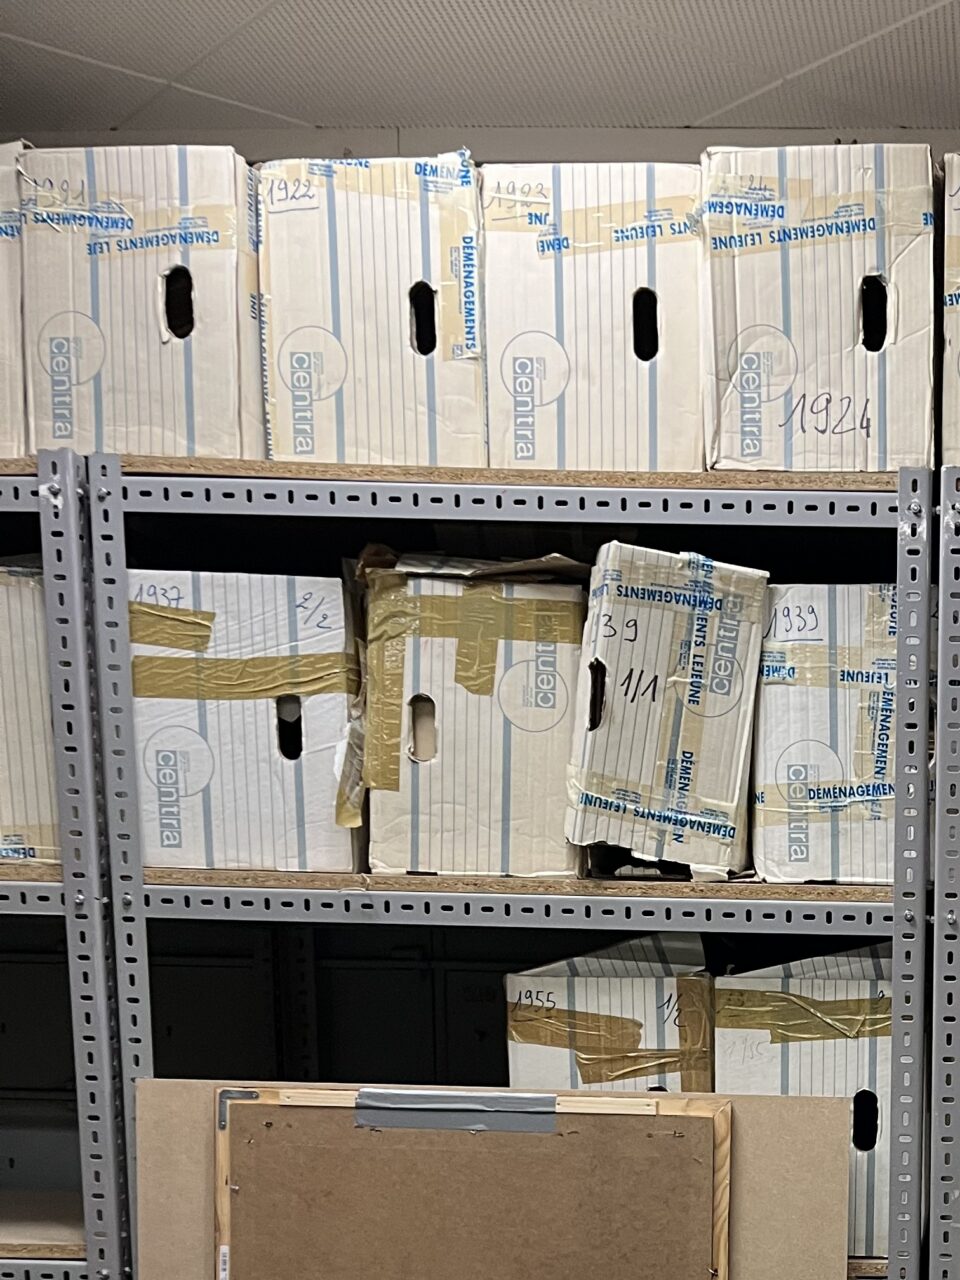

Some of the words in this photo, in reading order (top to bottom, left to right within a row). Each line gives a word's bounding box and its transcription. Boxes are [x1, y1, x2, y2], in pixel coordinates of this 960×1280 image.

[266, 178, 316, 205] 1922
[613, 223, 664, 243] LEJEUNE
[711, 234, 763, 250] LEJEUNE
[769, 216, 876, 245] DÉMÉNAGEMENTS
[461, 235, 478, 351] DÉMÉNAGEMENTS
[50, 337, 73, 439] centra
[290, 352, 314, 455] centra
[512, 356, 535, 460] centra
[741, 352, 763, 457] centra
[778, 392, 872, 440] 1924
[295, 592, 333, 630] 2/2
[763, 604, 821, 639] 1939
[620, 667, 659, 704] 1/1
[688, 654, 705, 707] LEJEUNE
[155, 749, 183, 849] centra
[510, 989, 557, 1013] 1955
